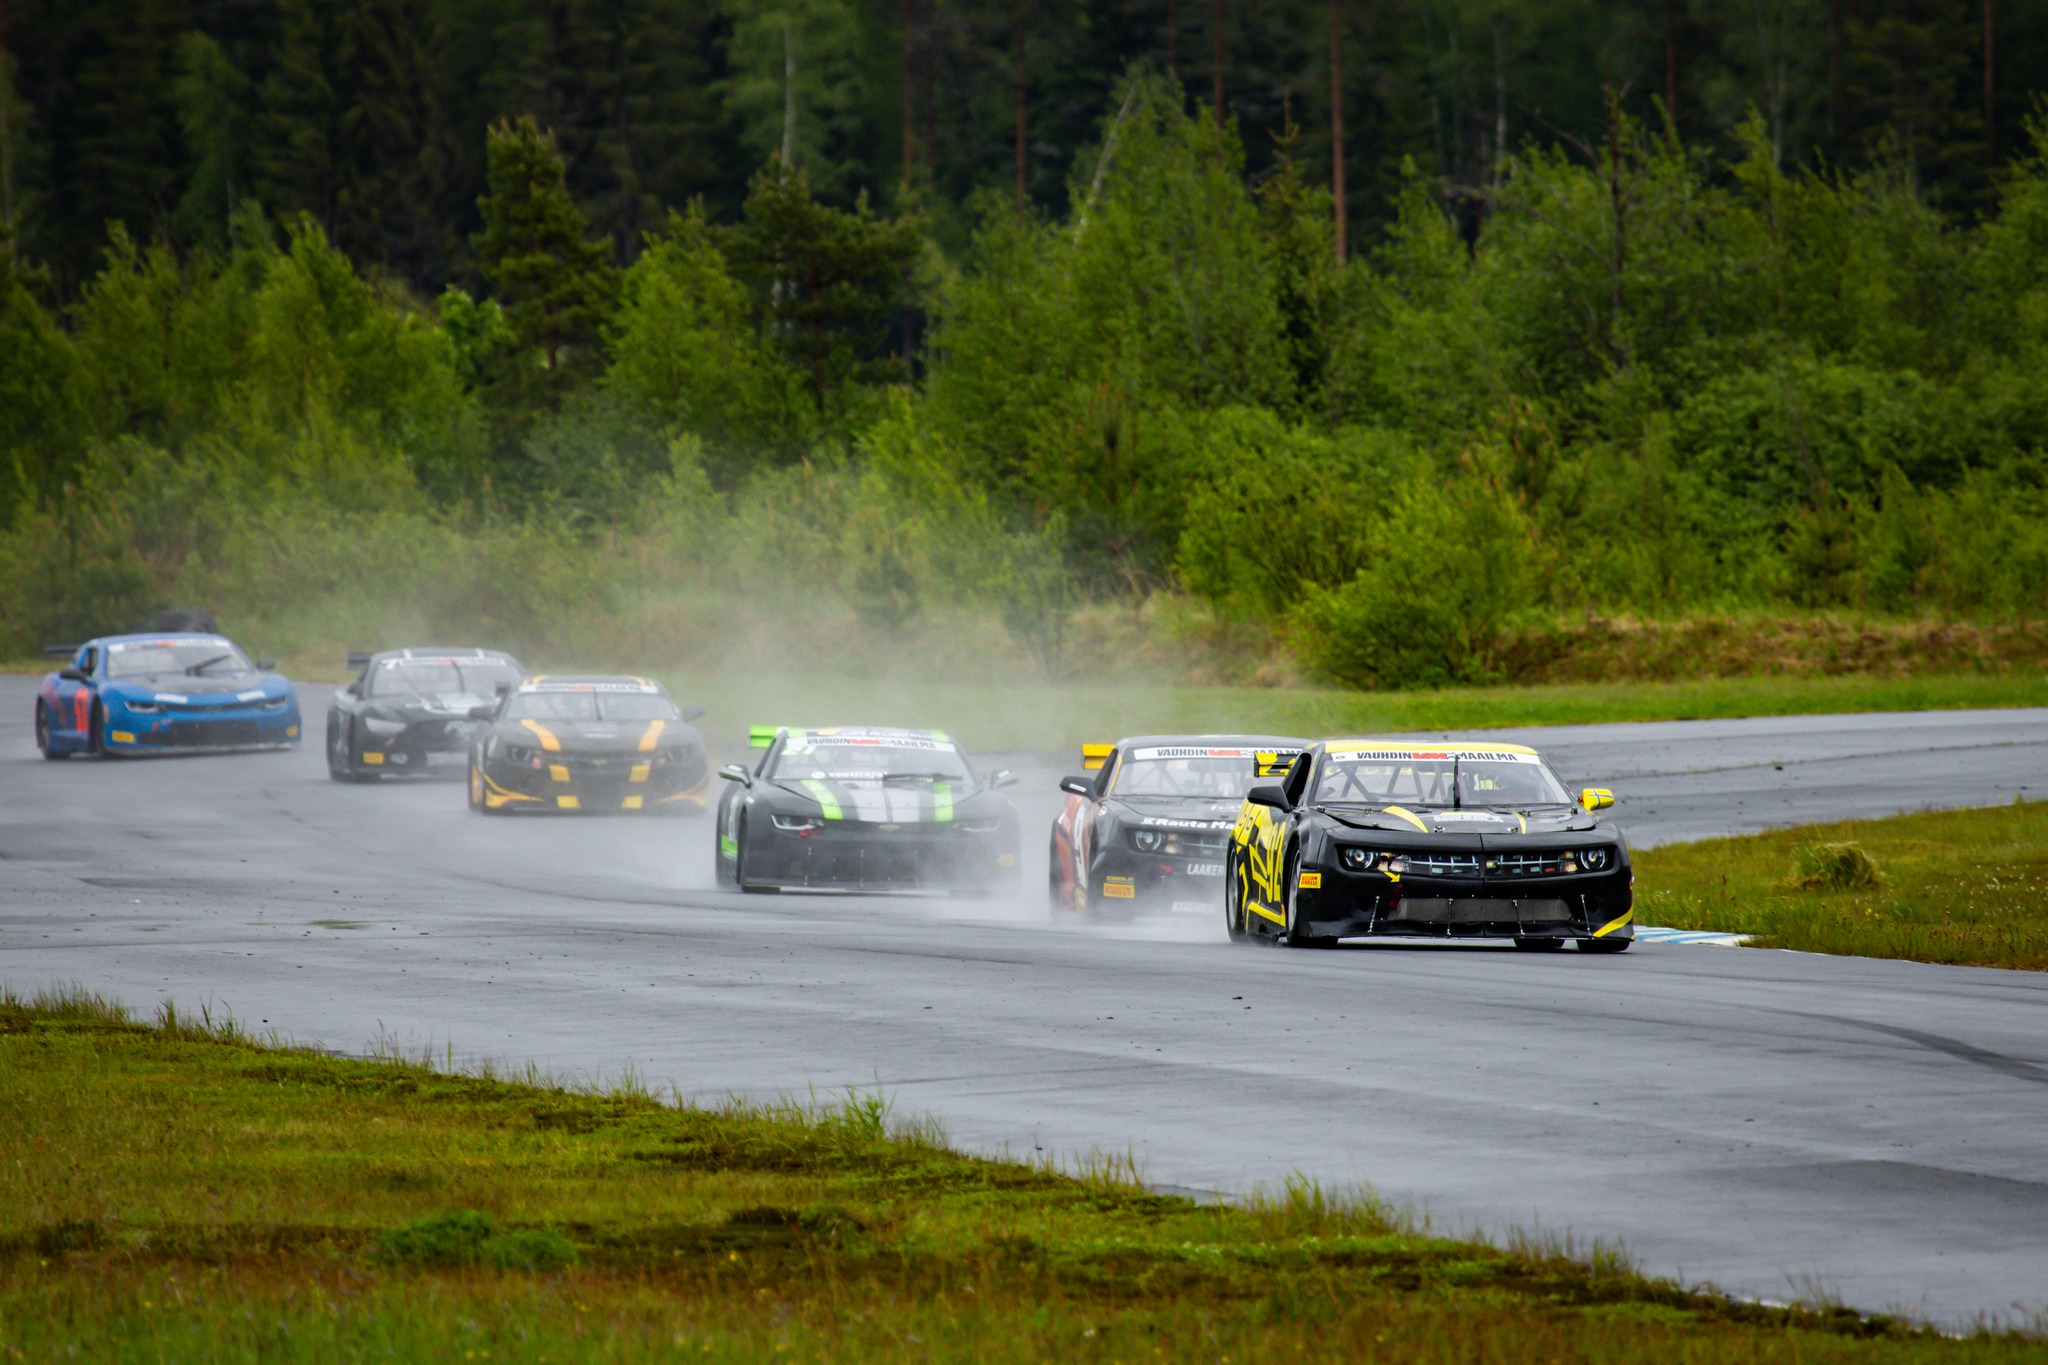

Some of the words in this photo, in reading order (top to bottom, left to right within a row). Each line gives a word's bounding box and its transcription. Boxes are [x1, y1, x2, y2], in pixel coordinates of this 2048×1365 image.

[1157, 748, 1208, 757] VAUHDIN
[1357, 752, 1412, 760] VAUHDIN
[1456, 752, 1518, 762] MAAILMA
